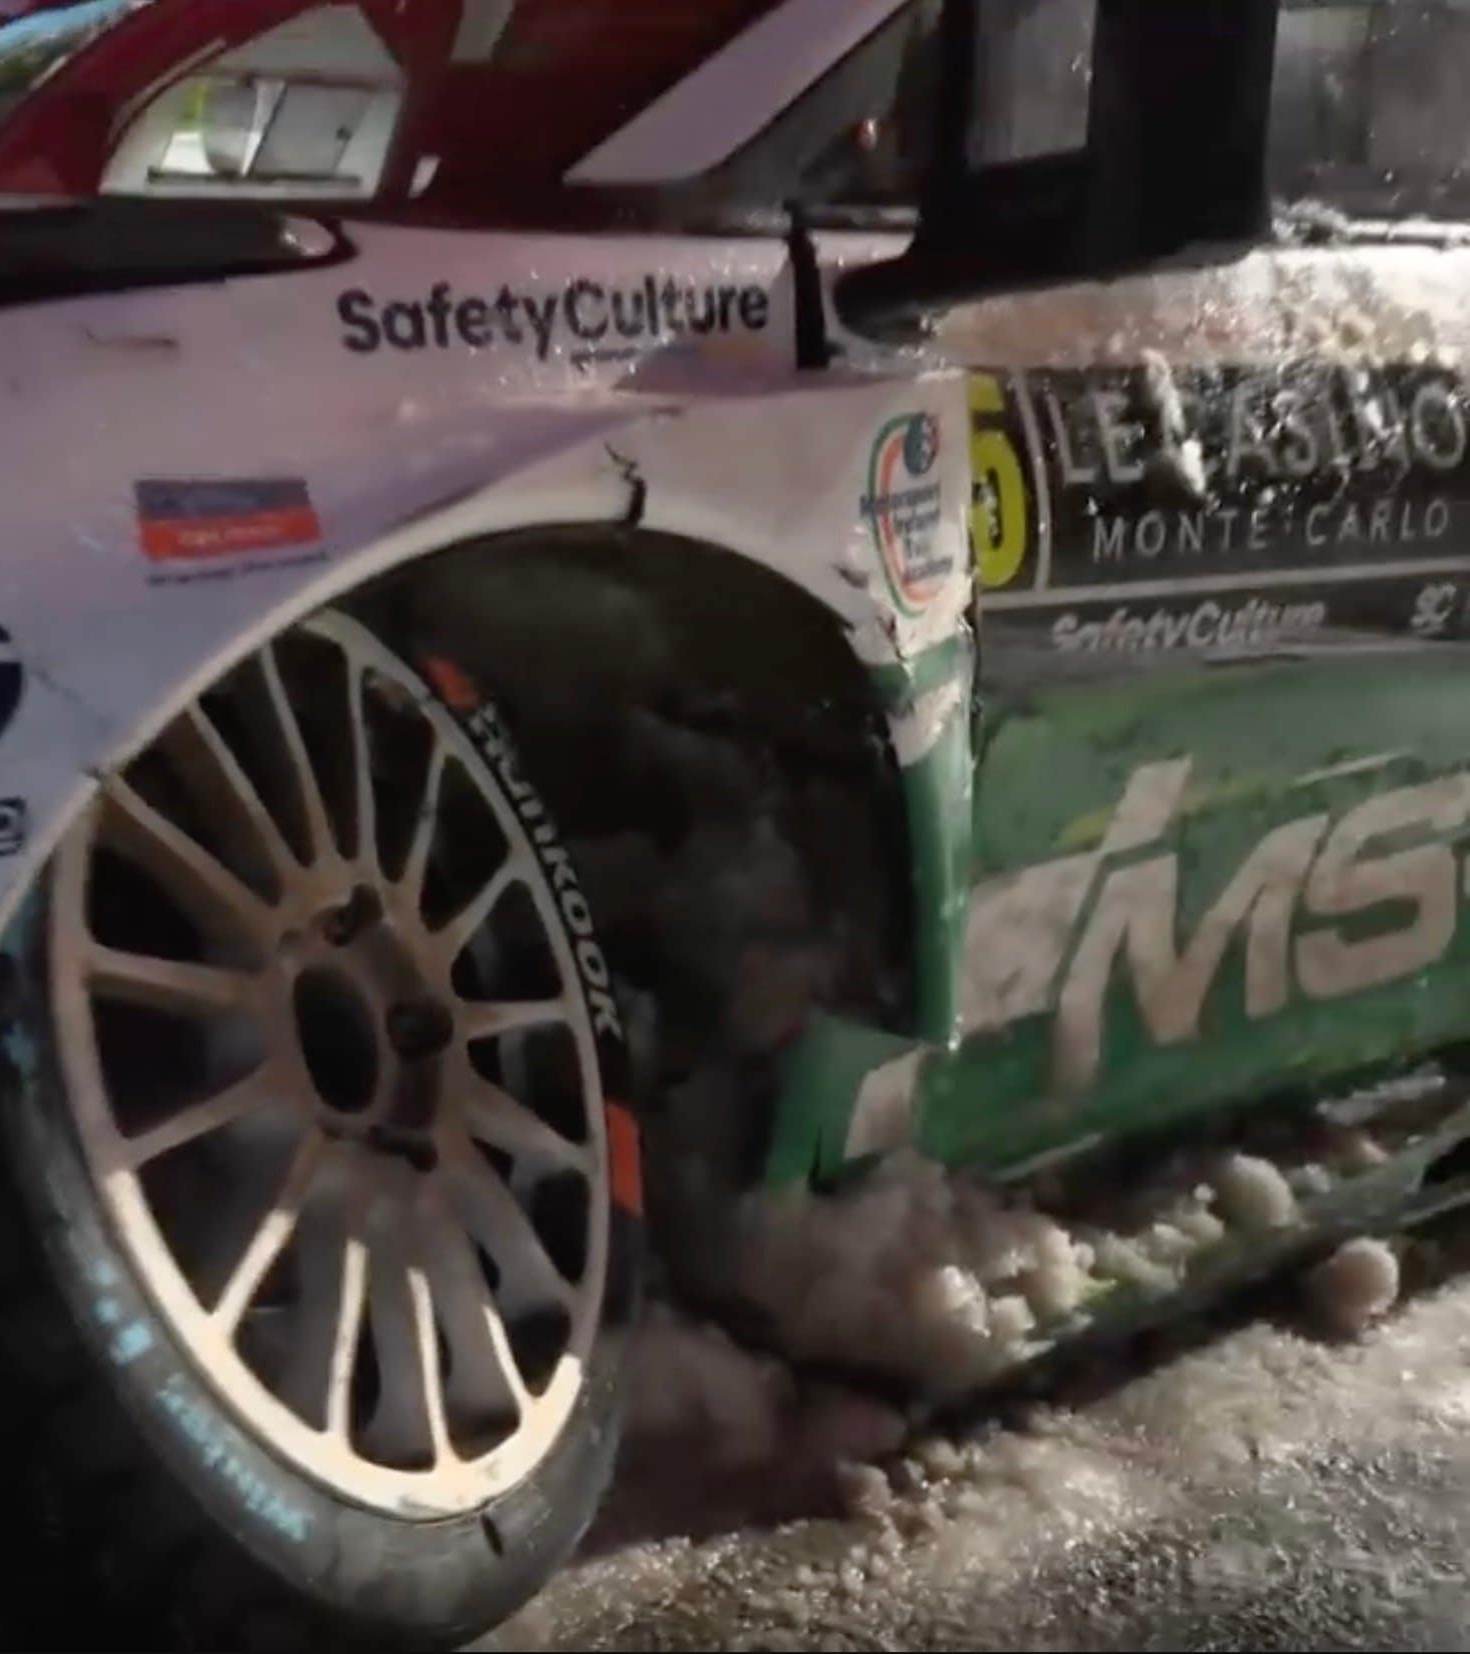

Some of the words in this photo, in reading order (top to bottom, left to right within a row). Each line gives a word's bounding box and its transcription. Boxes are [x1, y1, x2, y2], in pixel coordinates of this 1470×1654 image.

[336, 275, 768, 362] SafetyCulture
[1049, 389, 1147, 484] LE
[1092, 506, 1269, 563] MONTE
[1305, 501, 1450, 547] CARLO
[1051, 598, 1326, 655] SafetyCulture
